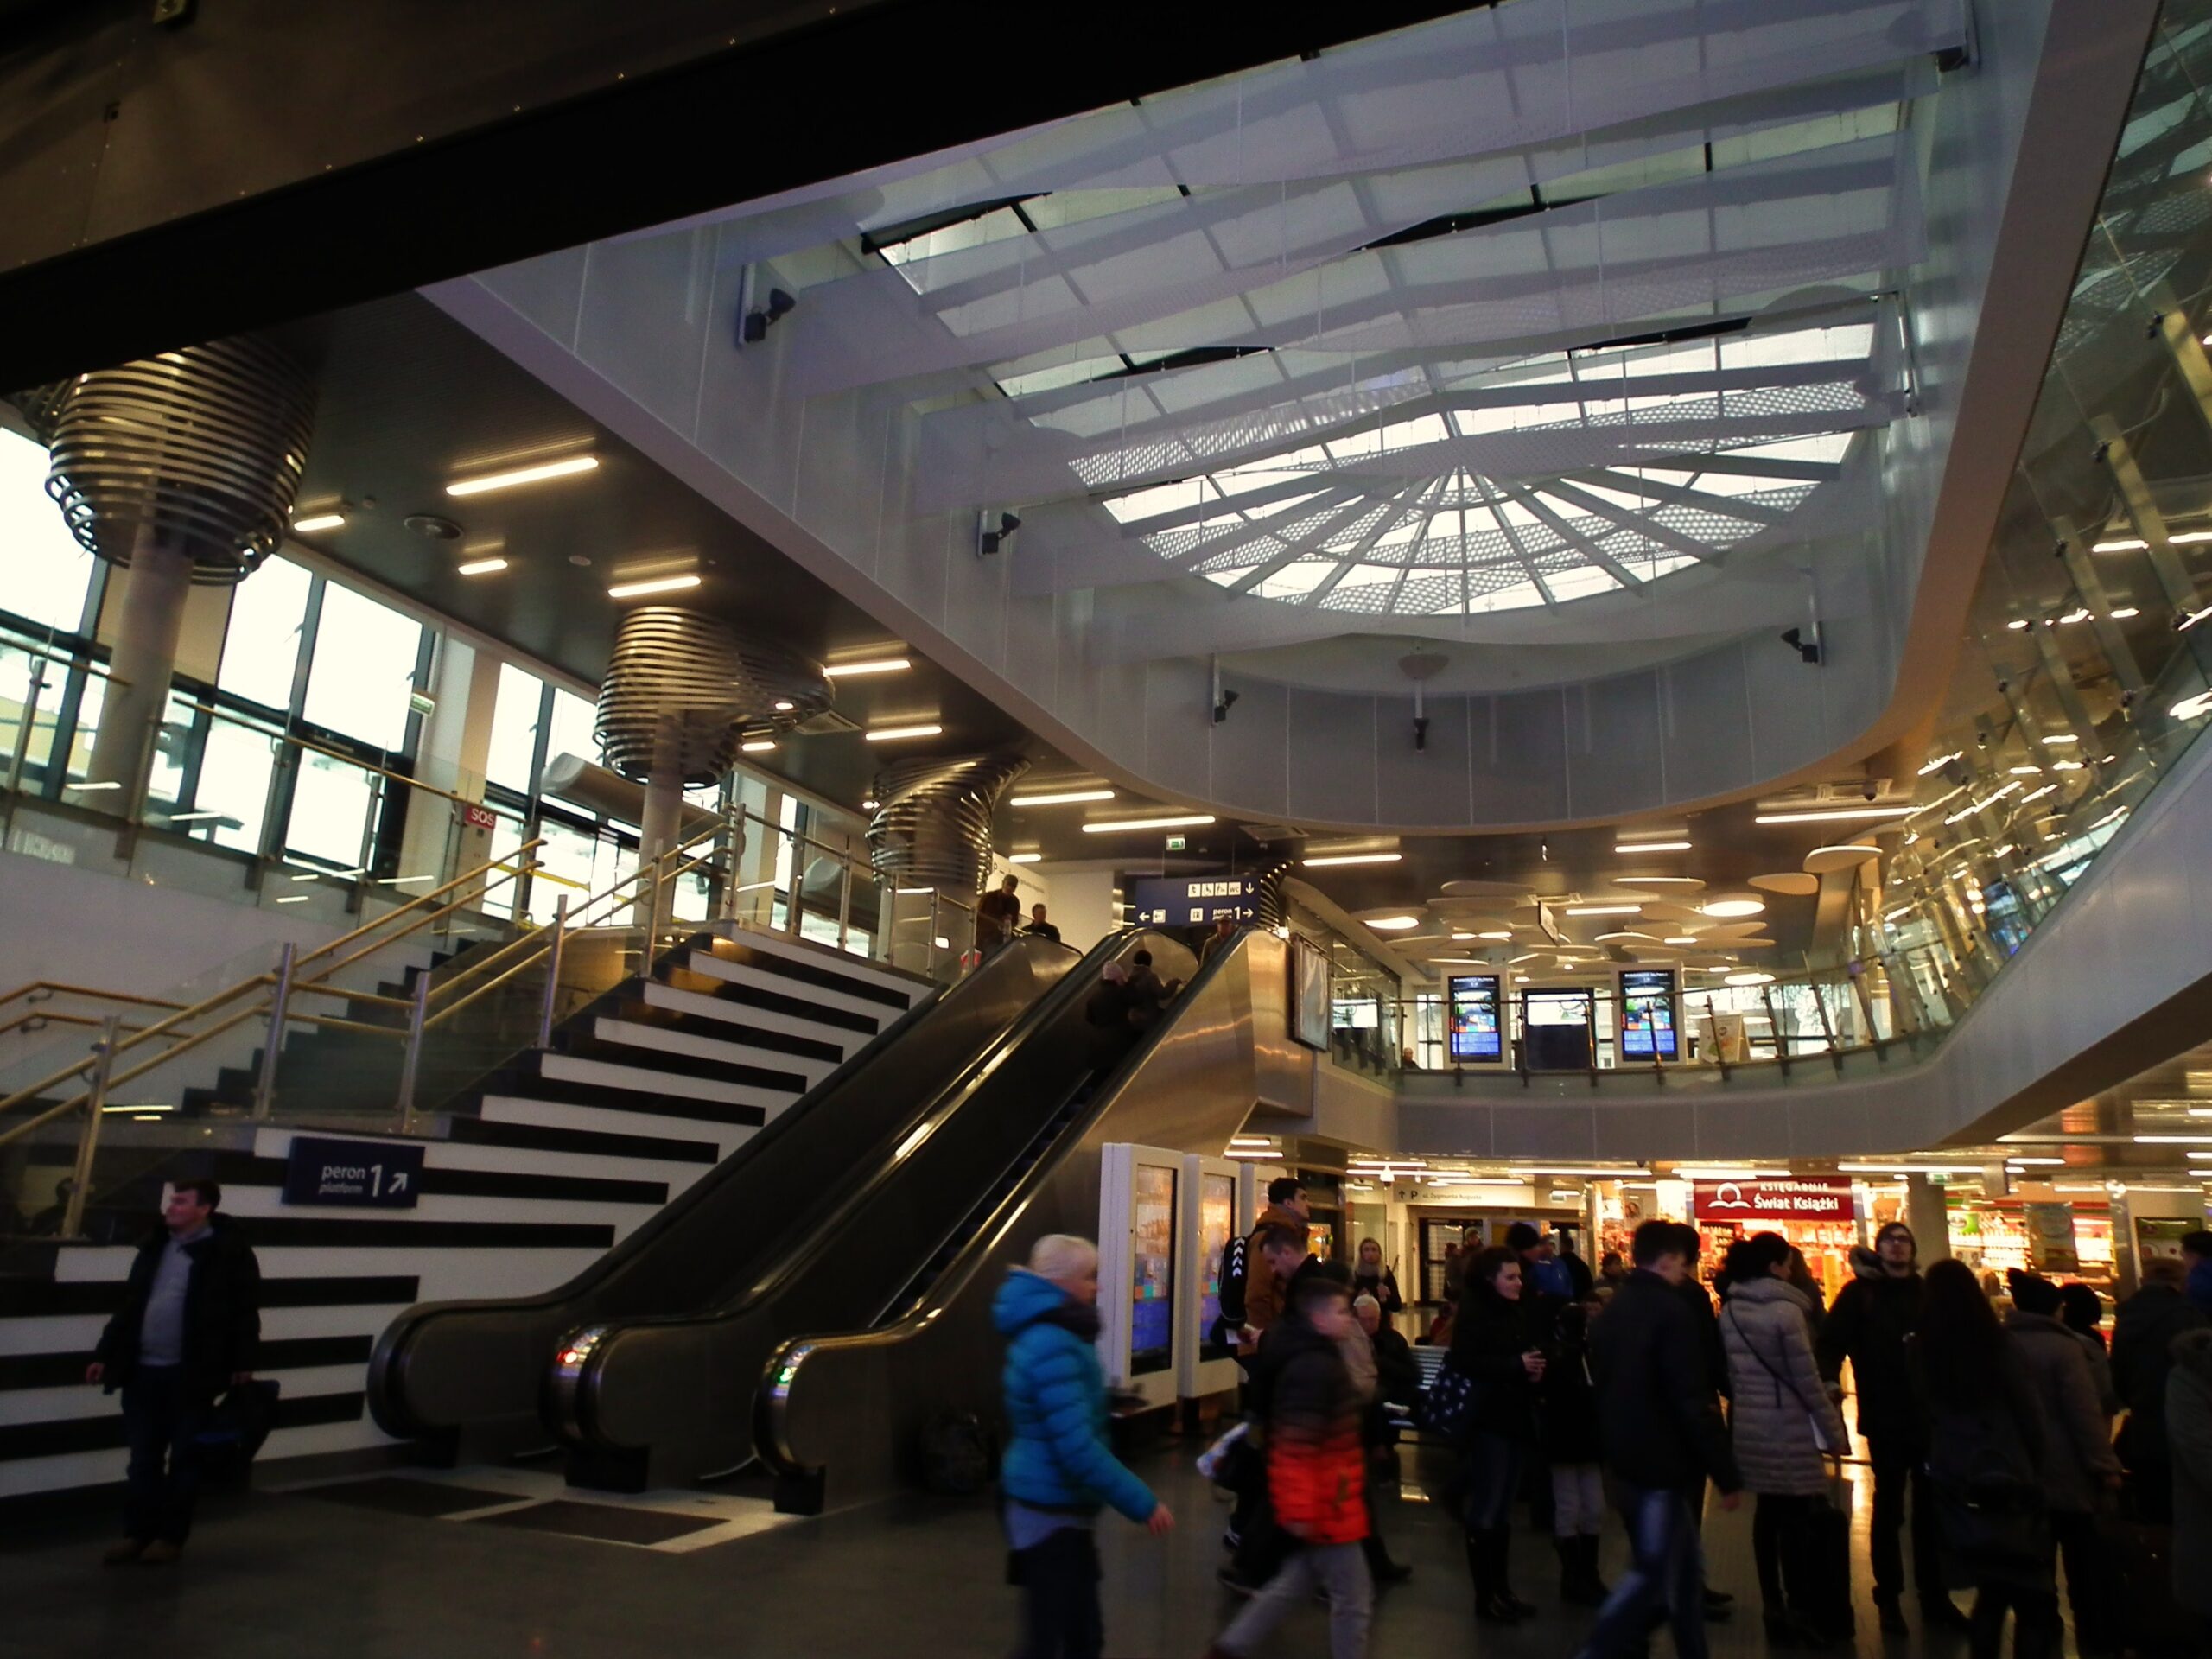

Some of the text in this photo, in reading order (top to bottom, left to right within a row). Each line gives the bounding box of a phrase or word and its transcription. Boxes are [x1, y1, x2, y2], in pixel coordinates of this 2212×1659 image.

[471, 808, 494, 825] SOS
[1235, 907, 1241, 919] 1
[321, 1164, 382, 1197] peron 1
[319, 1183, 363, 1194] platform
[1410, 1190, 1418, 1199] P
[1753, 1192, 1839, 1211] Świat Książki
